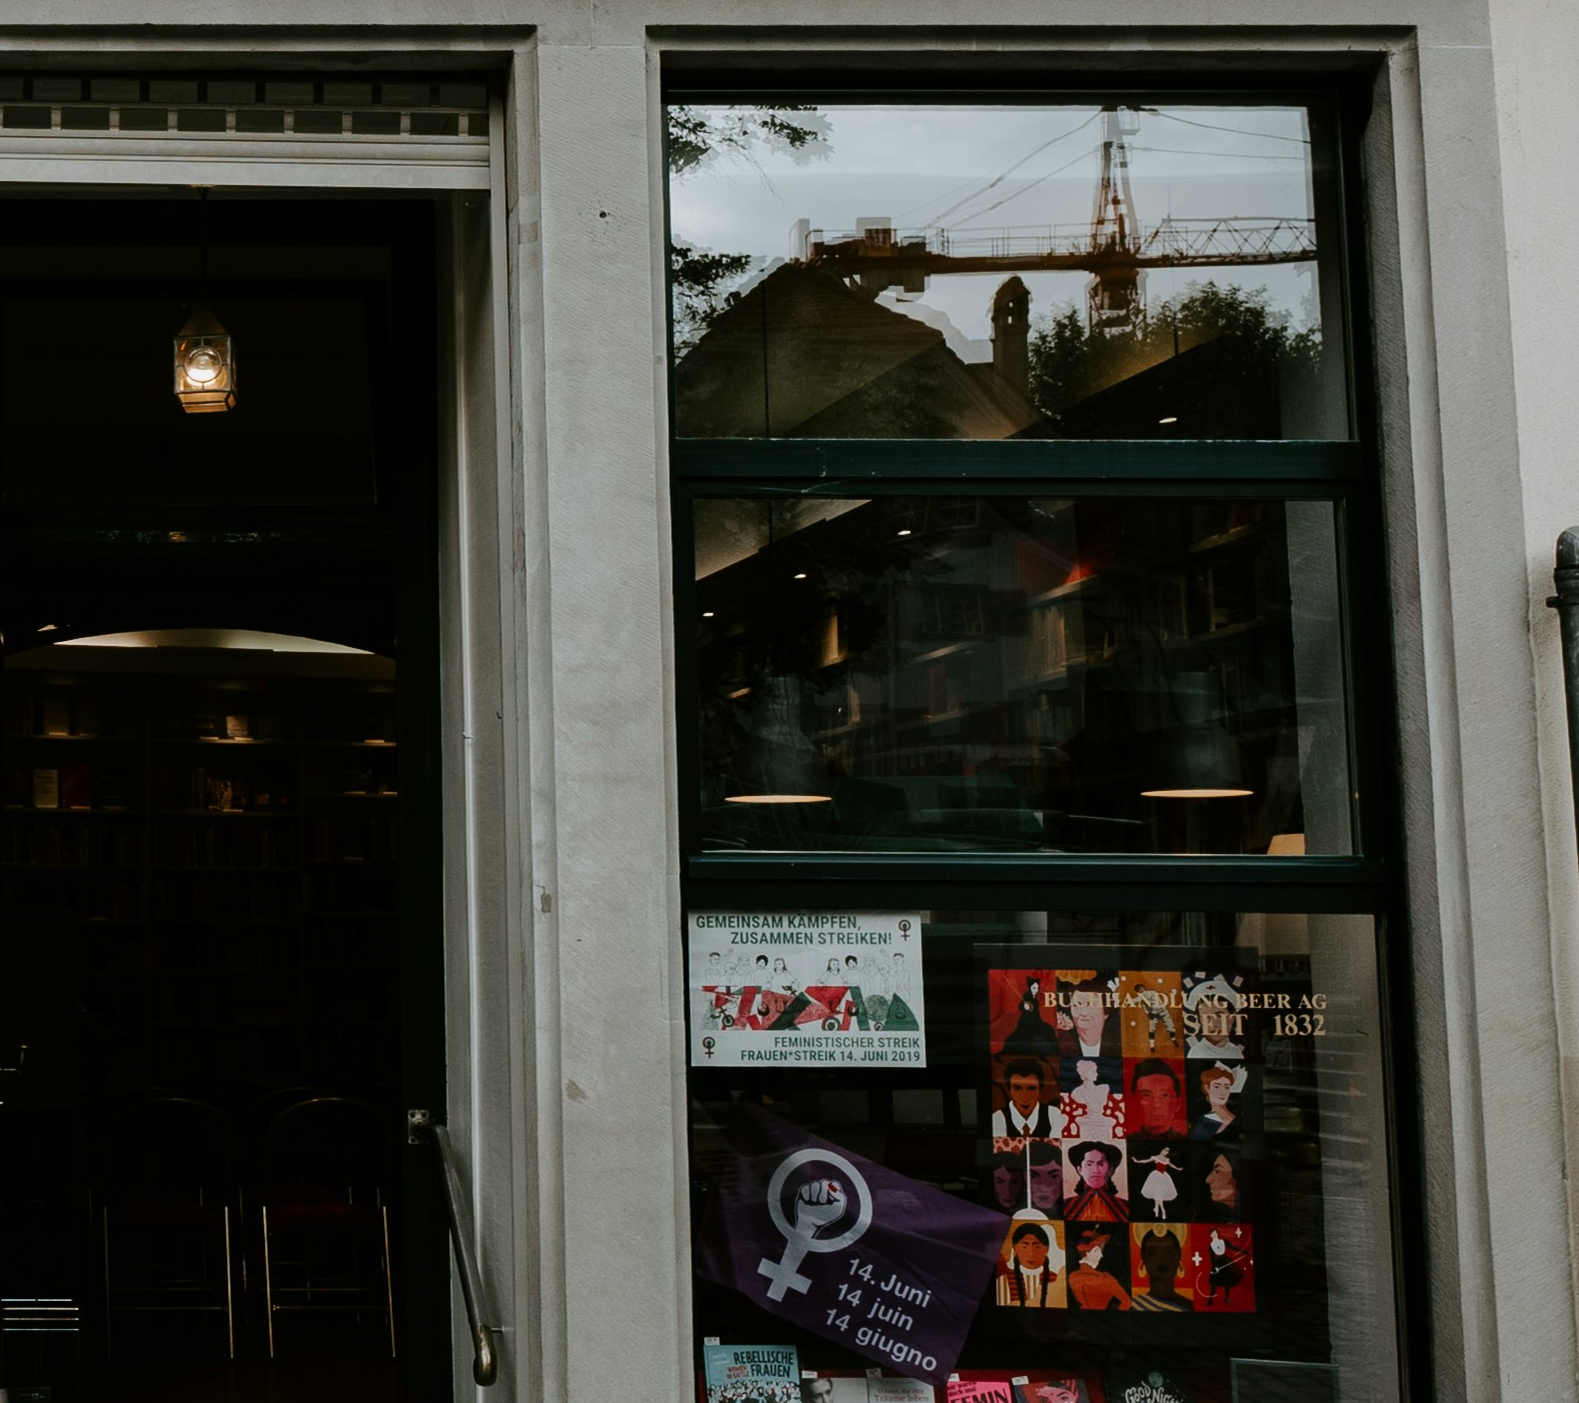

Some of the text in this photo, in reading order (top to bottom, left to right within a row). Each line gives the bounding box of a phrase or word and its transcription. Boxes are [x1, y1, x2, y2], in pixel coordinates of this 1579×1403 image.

[696, 913, 861, 930] GEMEINSAM KÄMPFEN,
[731, 932, 892, 945] ZUSAMMEN STREIKEN!
[1044, 992, 1327, 1009] BUCHHANDLUNG BEER AG
[1183, 1013, 1326, 1036] SEIT 1832
[774, 1037, 920, 1048] FEMINISTISCHER STREIK
[841, 1050, 858, 1062] 14.
[862, 1050, 888, 1062] JUNI
[891, 1050, 921, 1062] 2019
[849, 1258, 932, 1308] 14. Juni
[838, 1284, 914, 1331] 14 juin
[826, 1308, 937, 1371] 14 giugno
[733, 1350, 794, 1365] REBELLISCHE
[750, 1364, 791, 1378] FRAUEN
